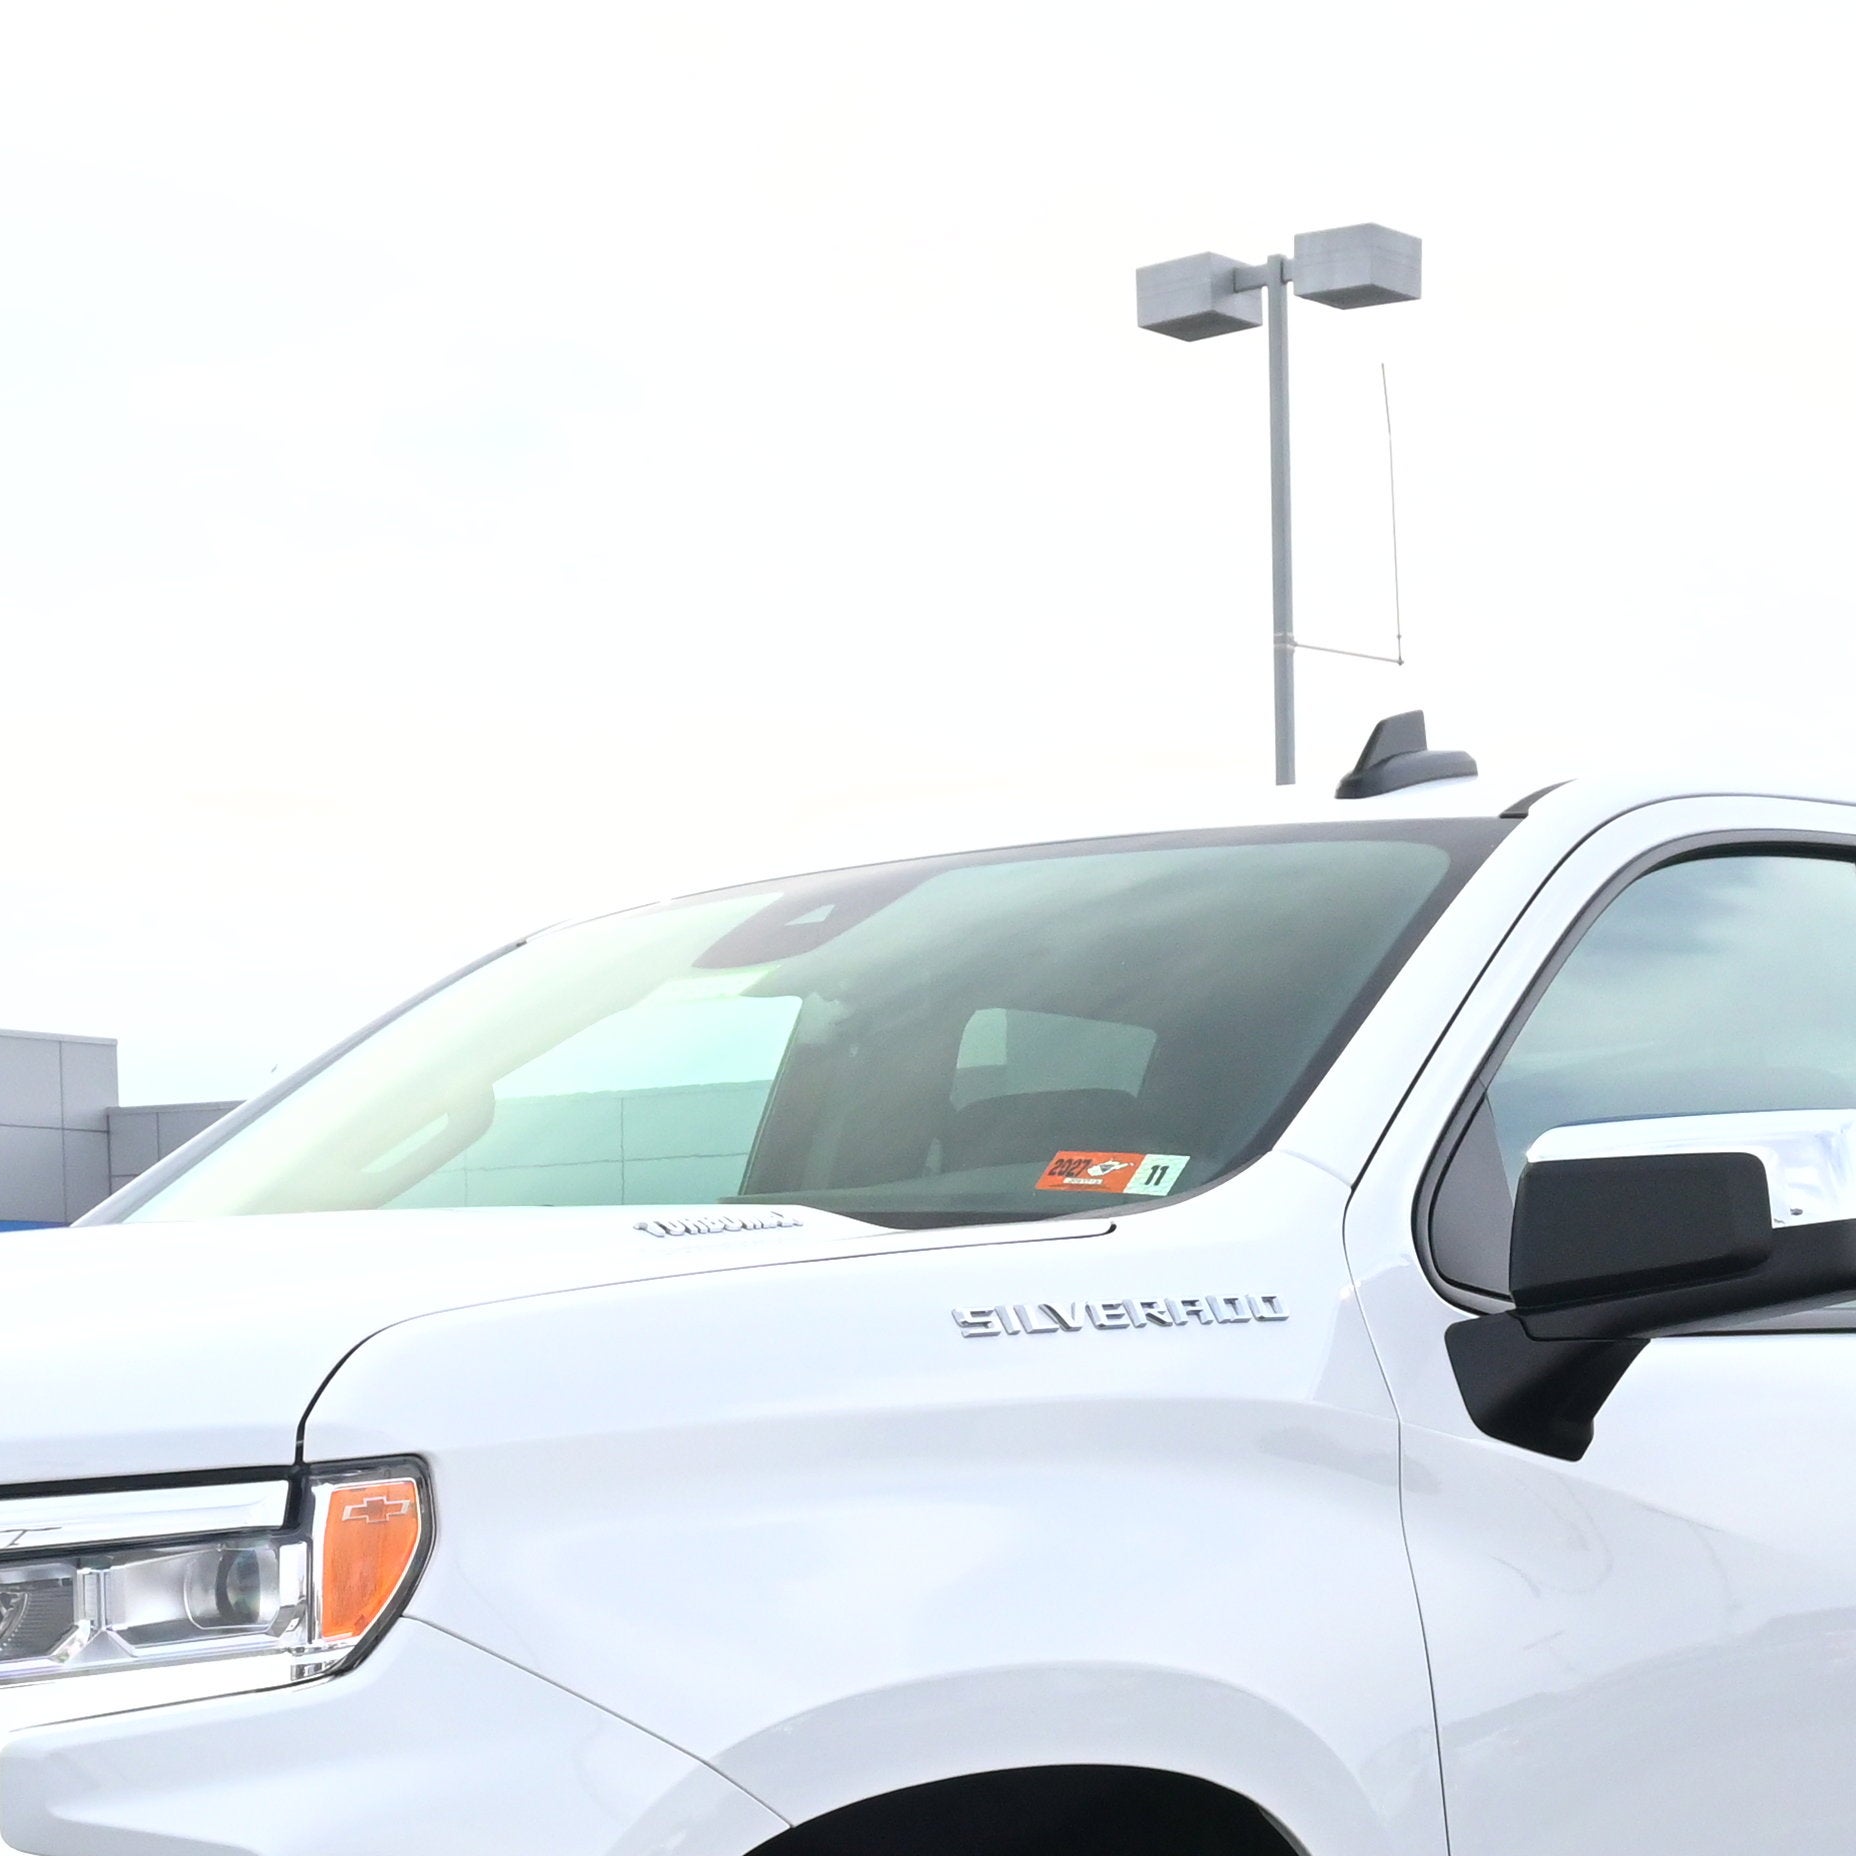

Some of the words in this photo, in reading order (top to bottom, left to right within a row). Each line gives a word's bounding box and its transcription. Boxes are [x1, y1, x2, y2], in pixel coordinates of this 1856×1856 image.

[1048, 1158, 1092, 1178] 2027
[1144, 1164, 1169, 1186] 11
[951, 1294, 1290, 1338] SILVERADO
